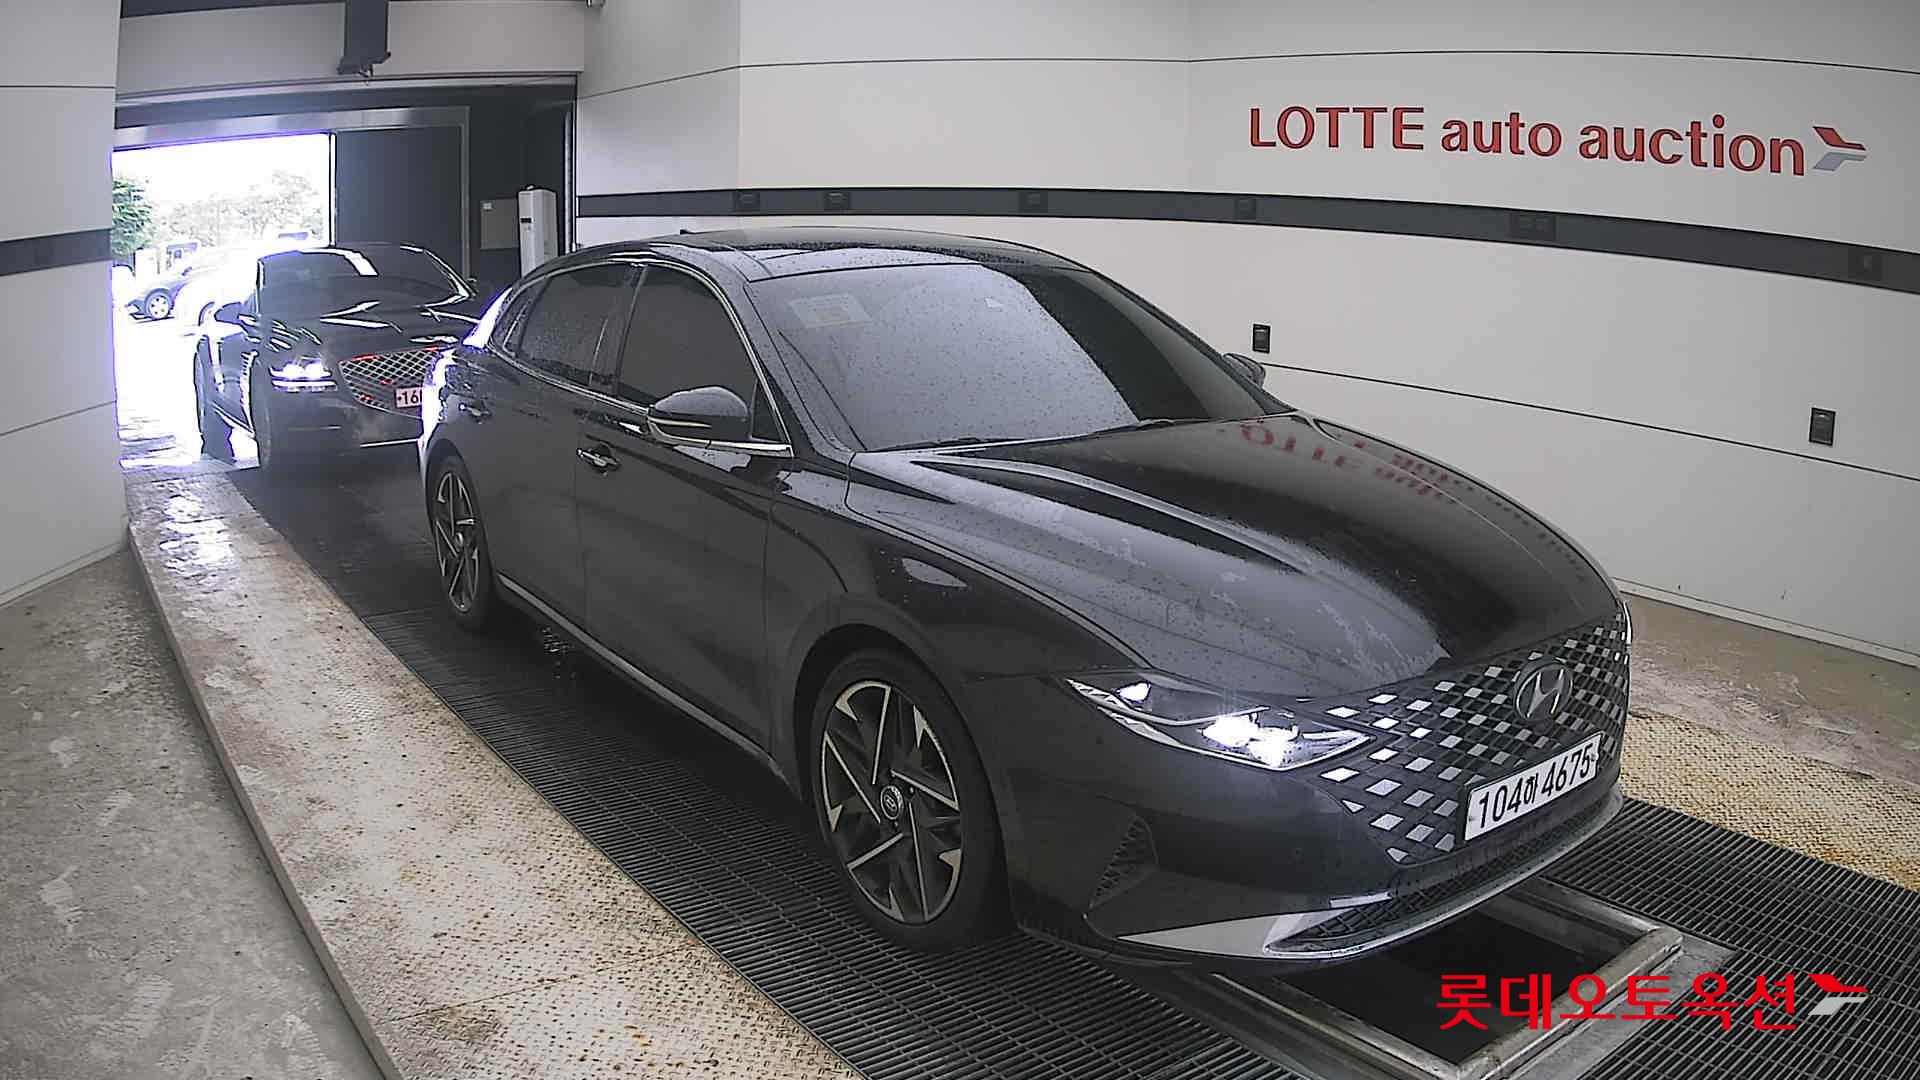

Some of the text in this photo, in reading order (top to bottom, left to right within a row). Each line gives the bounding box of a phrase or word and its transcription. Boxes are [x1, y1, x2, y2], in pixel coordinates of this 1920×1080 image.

[1250, 106, 1805, 176] LOTTE auto auction
[1541, 742, 1594, 797] 4675
